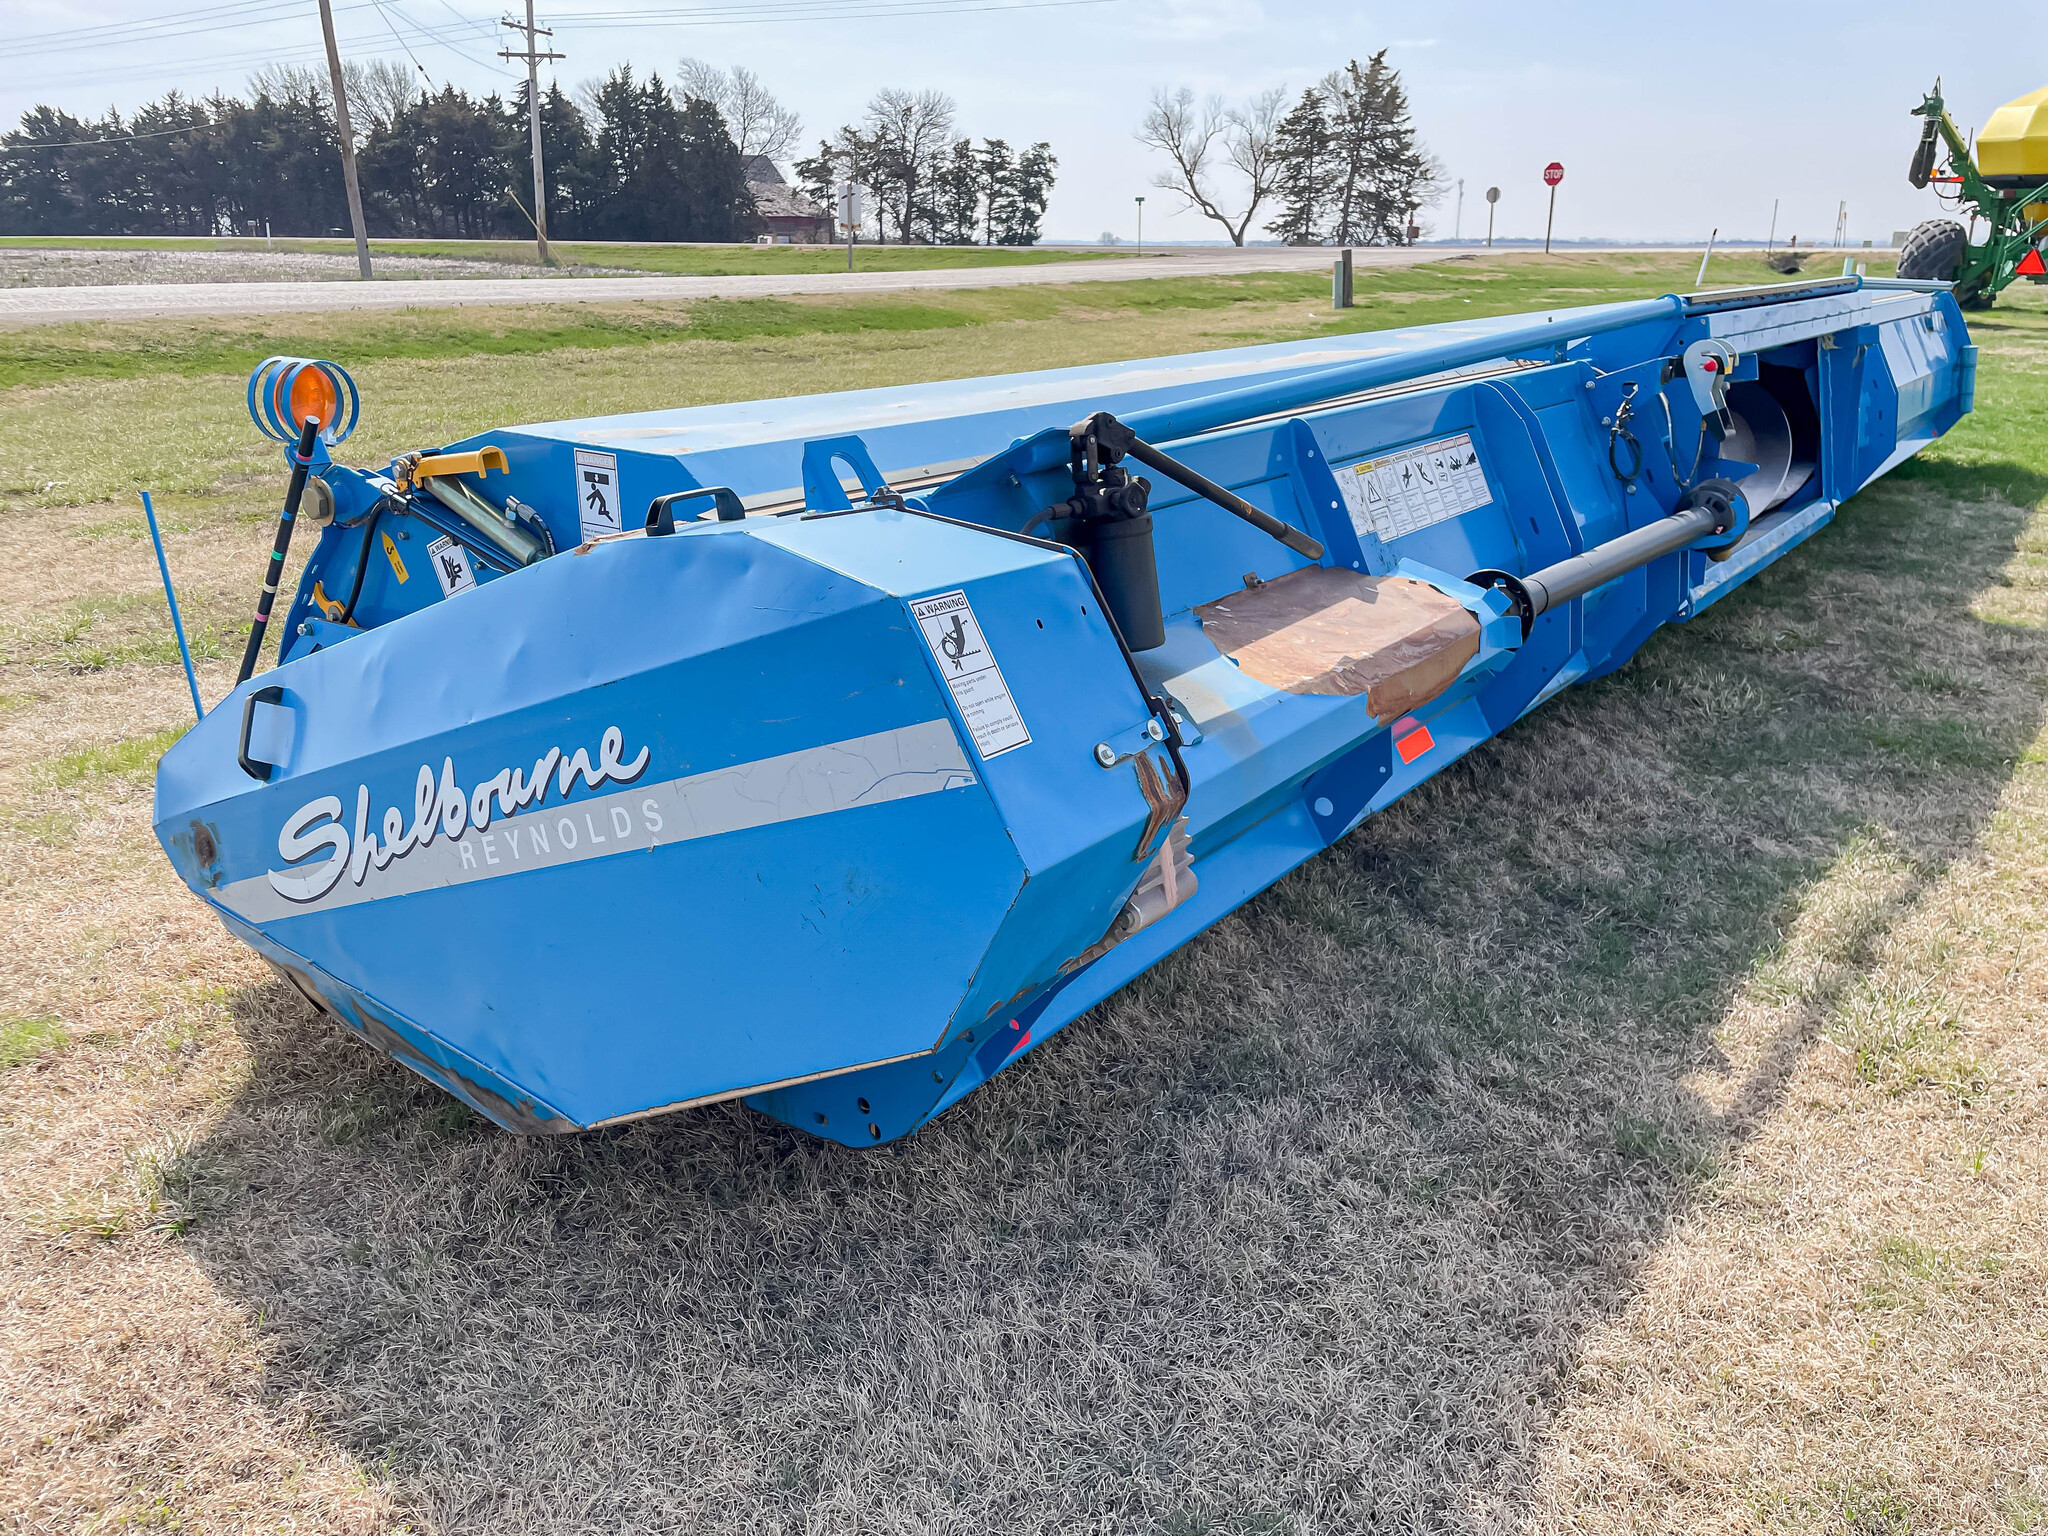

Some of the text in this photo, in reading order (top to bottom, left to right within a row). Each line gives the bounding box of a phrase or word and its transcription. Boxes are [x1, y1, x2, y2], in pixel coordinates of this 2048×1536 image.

[1545, 169, 1562, 179] STOP
[584, 455, 613, 466] DANGER
[925, 597, 964, 614] WARNING
[267, 725, 650, 904] Shelbourne
[458, 798, 664, 870] REYNOLDS
